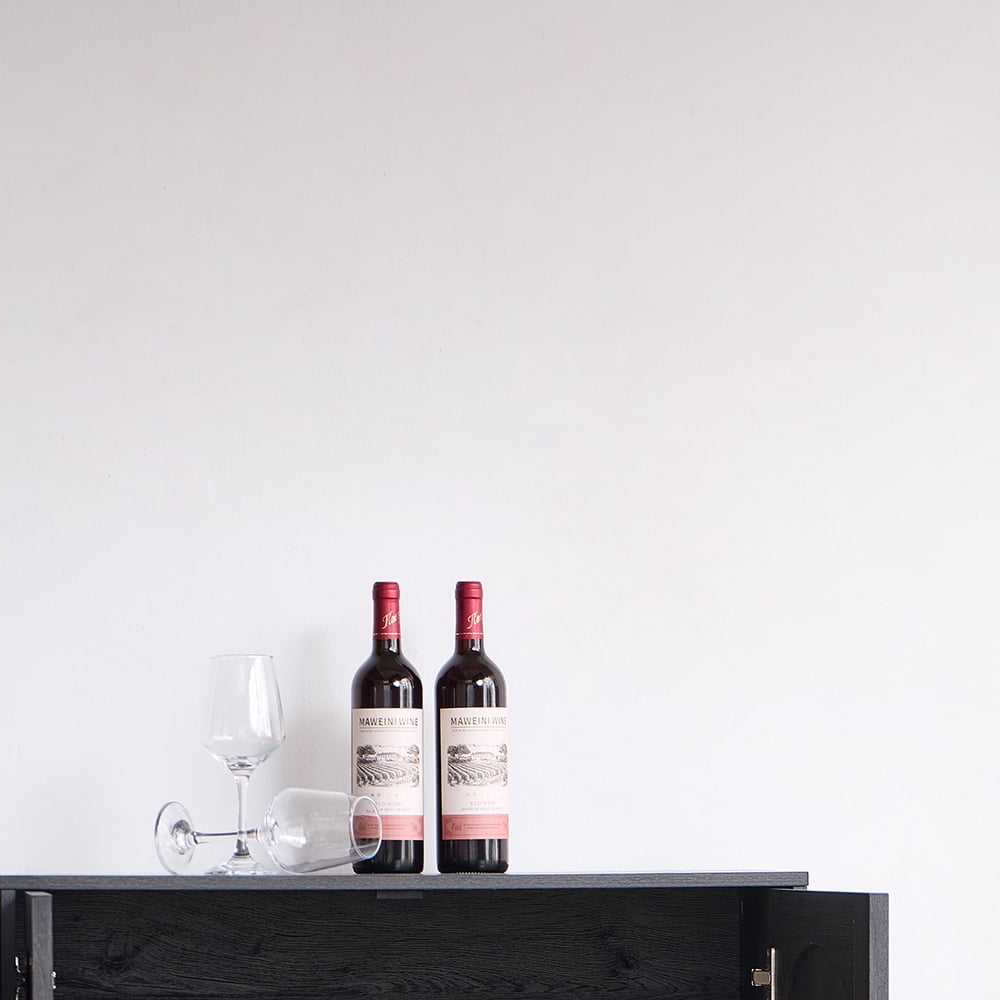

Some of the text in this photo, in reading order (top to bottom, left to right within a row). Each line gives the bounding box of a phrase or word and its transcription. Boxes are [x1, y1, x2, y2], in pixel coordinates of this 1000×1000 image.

[358, 717, 418, 727] MAWEINI WINE
[450, 717, 507, 726] MAWEINI WINE
